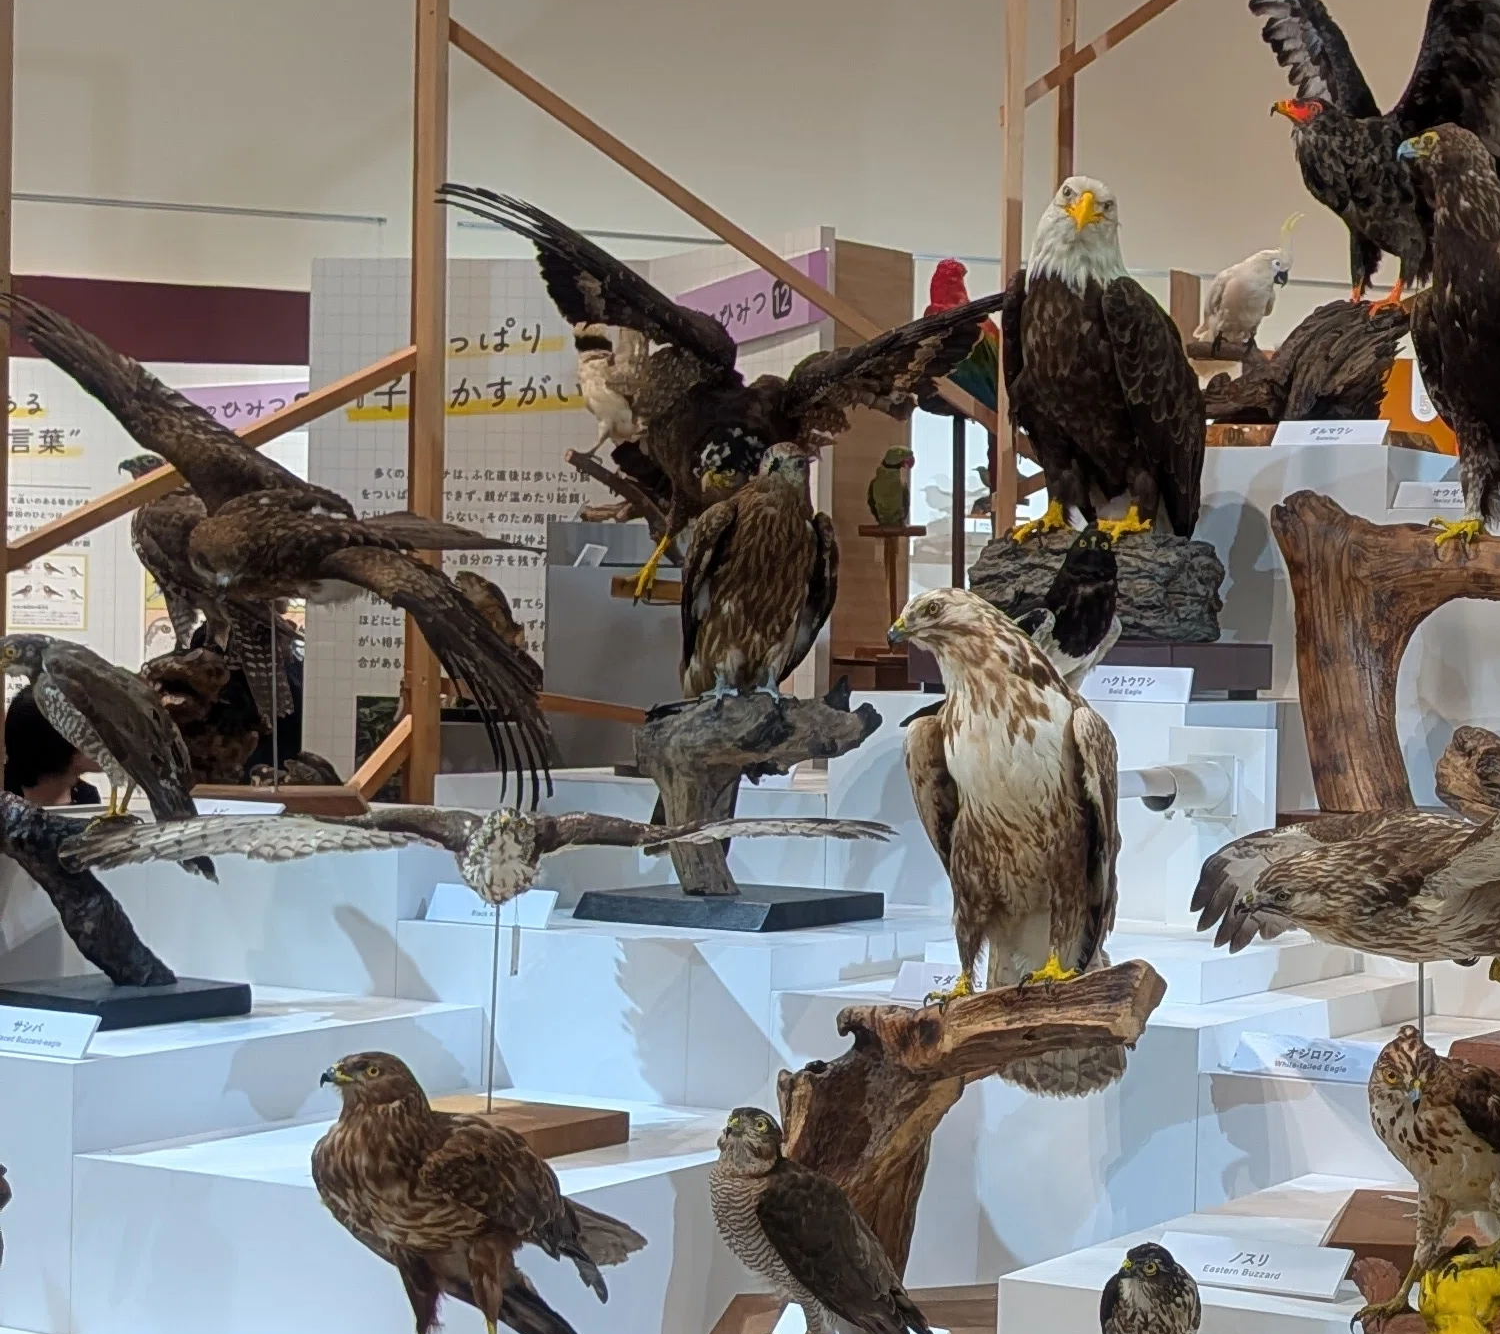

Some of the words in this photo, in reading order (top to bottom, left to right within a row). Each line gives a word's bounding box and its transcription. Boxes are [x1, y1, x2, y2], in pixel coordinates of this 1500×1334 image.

[774, 284, 790, 314] 12
[1432, 489, 1464, 497] オウギ
[1102, 676, 1156, 687] ハクトウワシ
[1286, 1047, 1347, 1062] オジロワシ
[1229, 1251, 1270, 1267] ノスリ
[1203, 1264, 1239, 1276] Eastern
[1242, 1268, 1281, 1280] Buzzard
